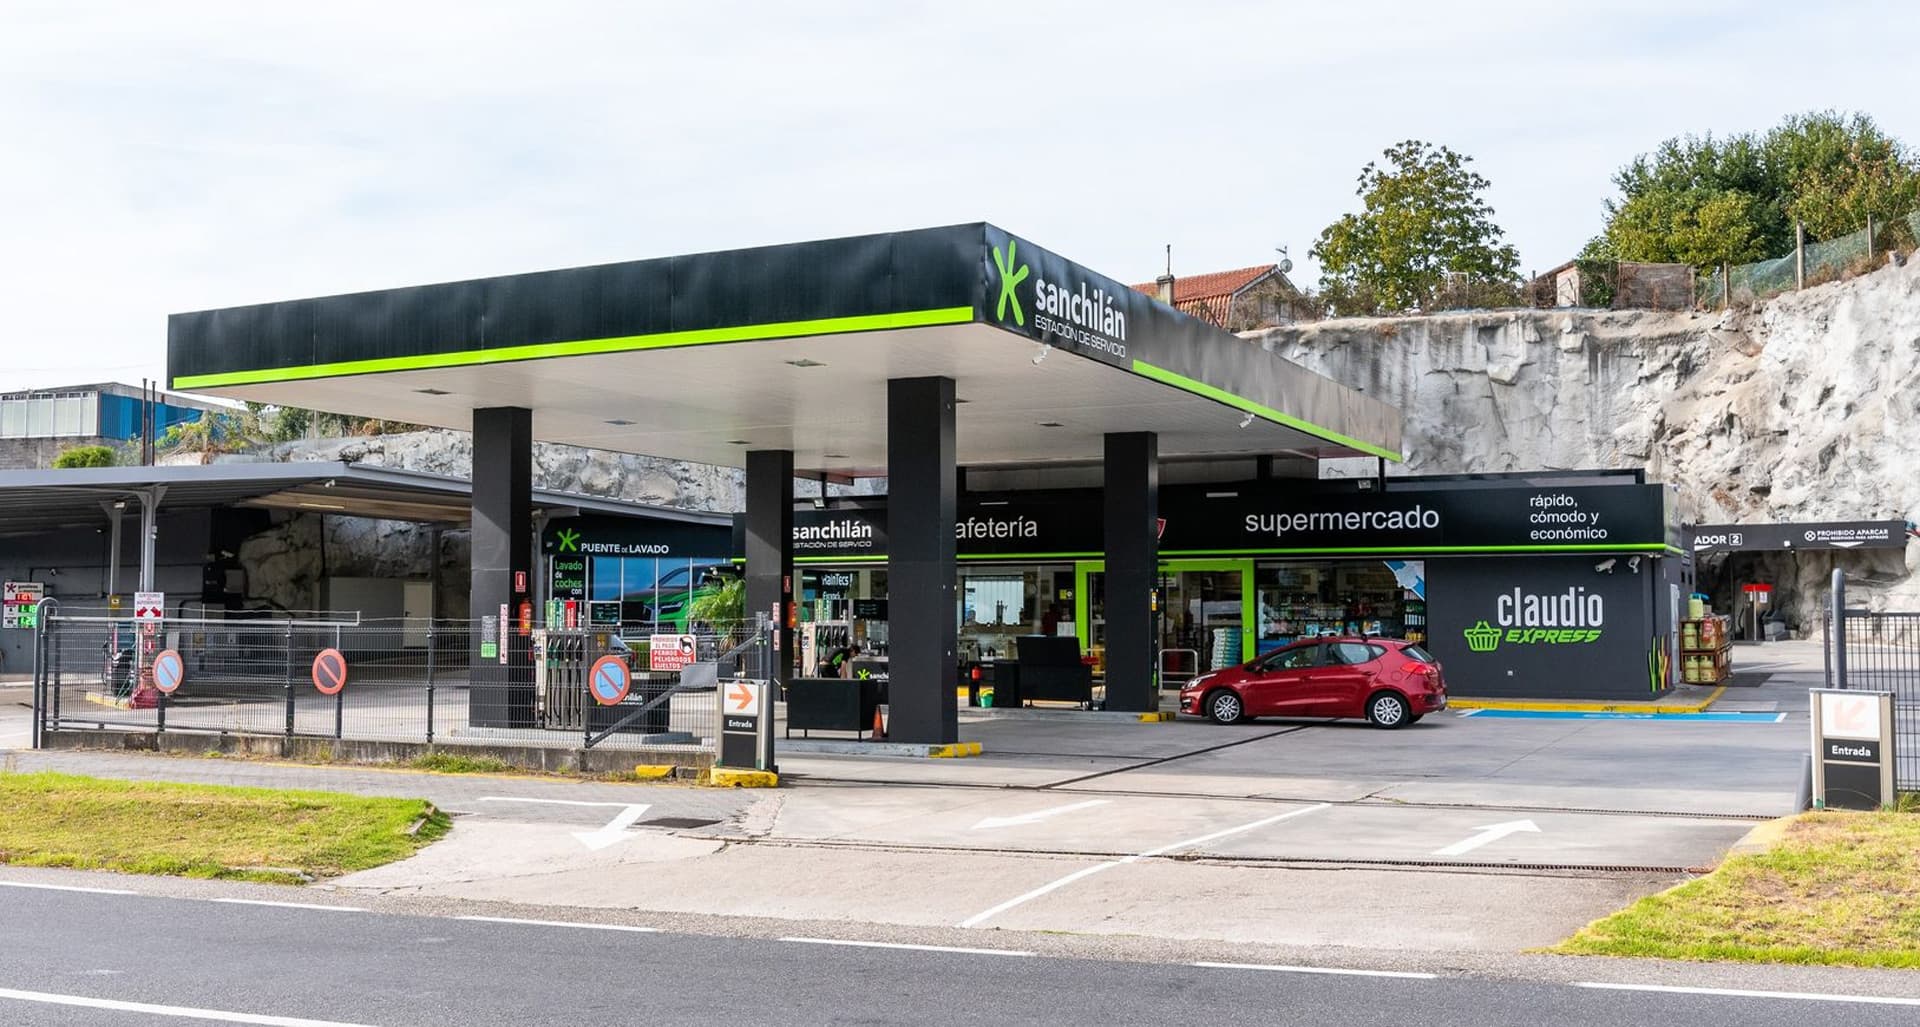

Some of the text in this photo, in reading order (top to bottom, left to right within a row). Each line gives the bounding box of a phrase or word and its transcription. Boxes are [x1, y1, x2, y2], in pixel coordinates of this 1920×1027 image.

[1035, 279, 1126, 341] sanchilán
[1035, 314, 1126, 358] ESTACIÓN DE SERVICIO
[1530, 493, 1578, 510] rápido,
[1245, 504, 1440, 537] supermercado
[1530, 510, 1600, 526] cómodo y
[793, 519, 872, 540] sanchilán
[955, 515, 1038, 539] afetería
[1530, 526, 1608, 540] económico
[1817, 528, 1889, 537] PROHIBIDO APARCAR
[827, 541, 838, 549] DE
[838, 540, 872, 548] SERVICIO
[1694, 535, 1727, 545] ADOR
[581, 543, 620, 553] PUENTE
[629, 544, 669, 554] LAVADO
[555, 561, 583, 570] Lavado
[555, 579, 583, 588] coches
[1498, 586, 1604, 628] claudio
[1505, 628, 1602, 645] EXPRESS
[728, 719, 753, 729] Entrada
[1832, 744, 1872, 758] Entrada
